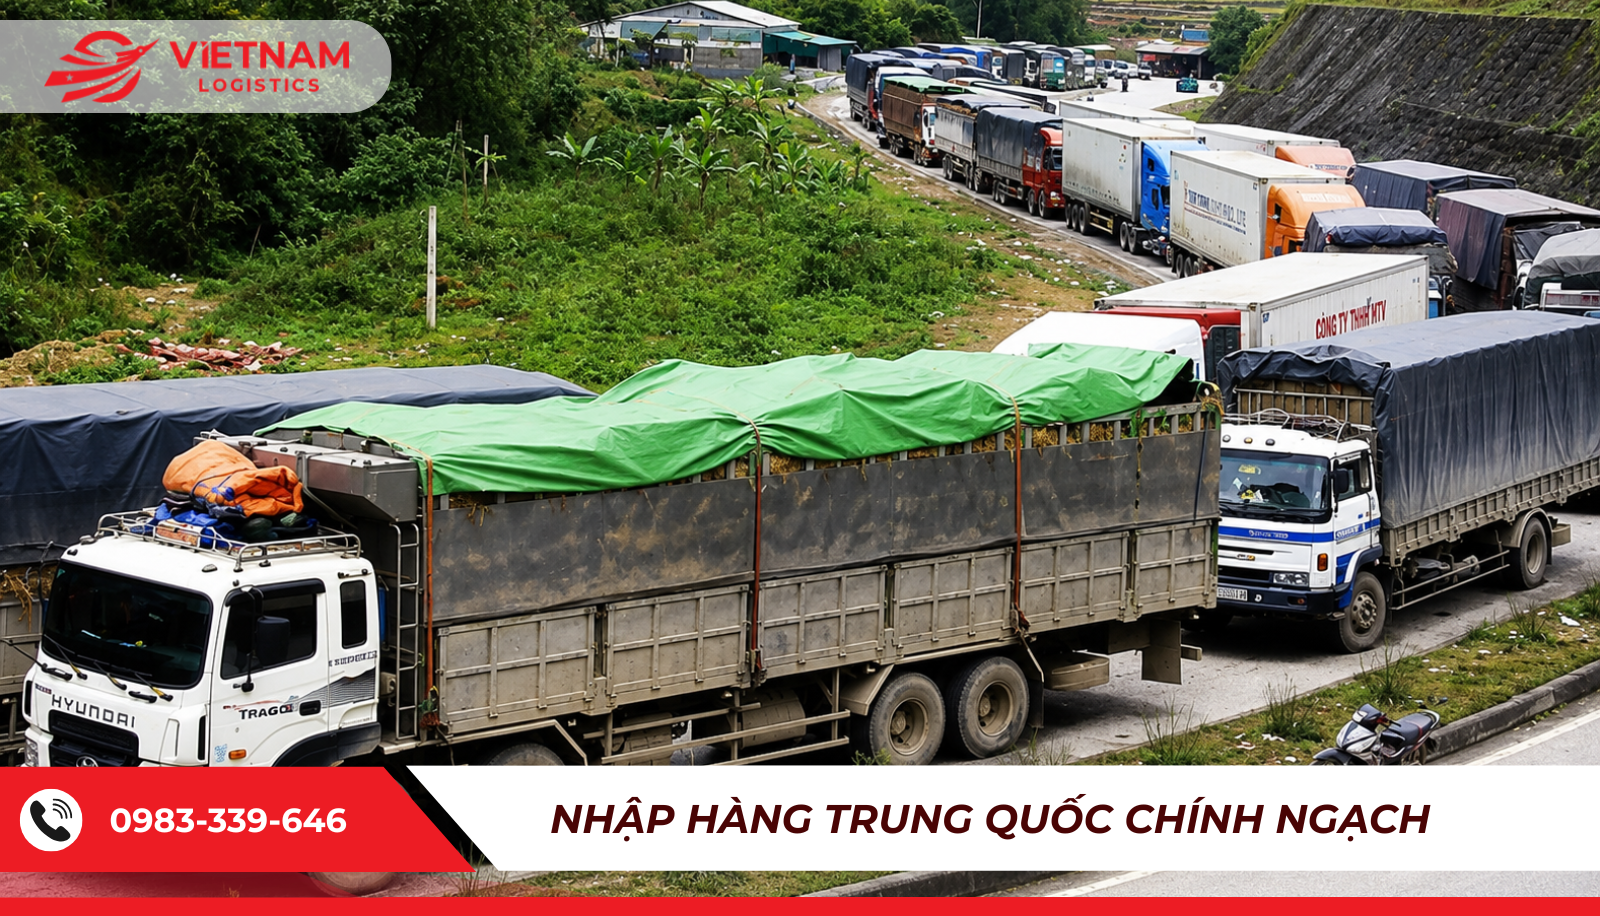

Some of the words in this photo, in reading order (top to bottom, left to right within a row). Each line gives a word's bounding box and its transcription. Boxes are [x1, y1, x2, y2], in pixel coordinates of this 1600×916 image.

[1338, 309, 1349, 335] TY
[1371, 299, 1387, 325] MTV
[51, 694, 136, 728] HYUNDAI
